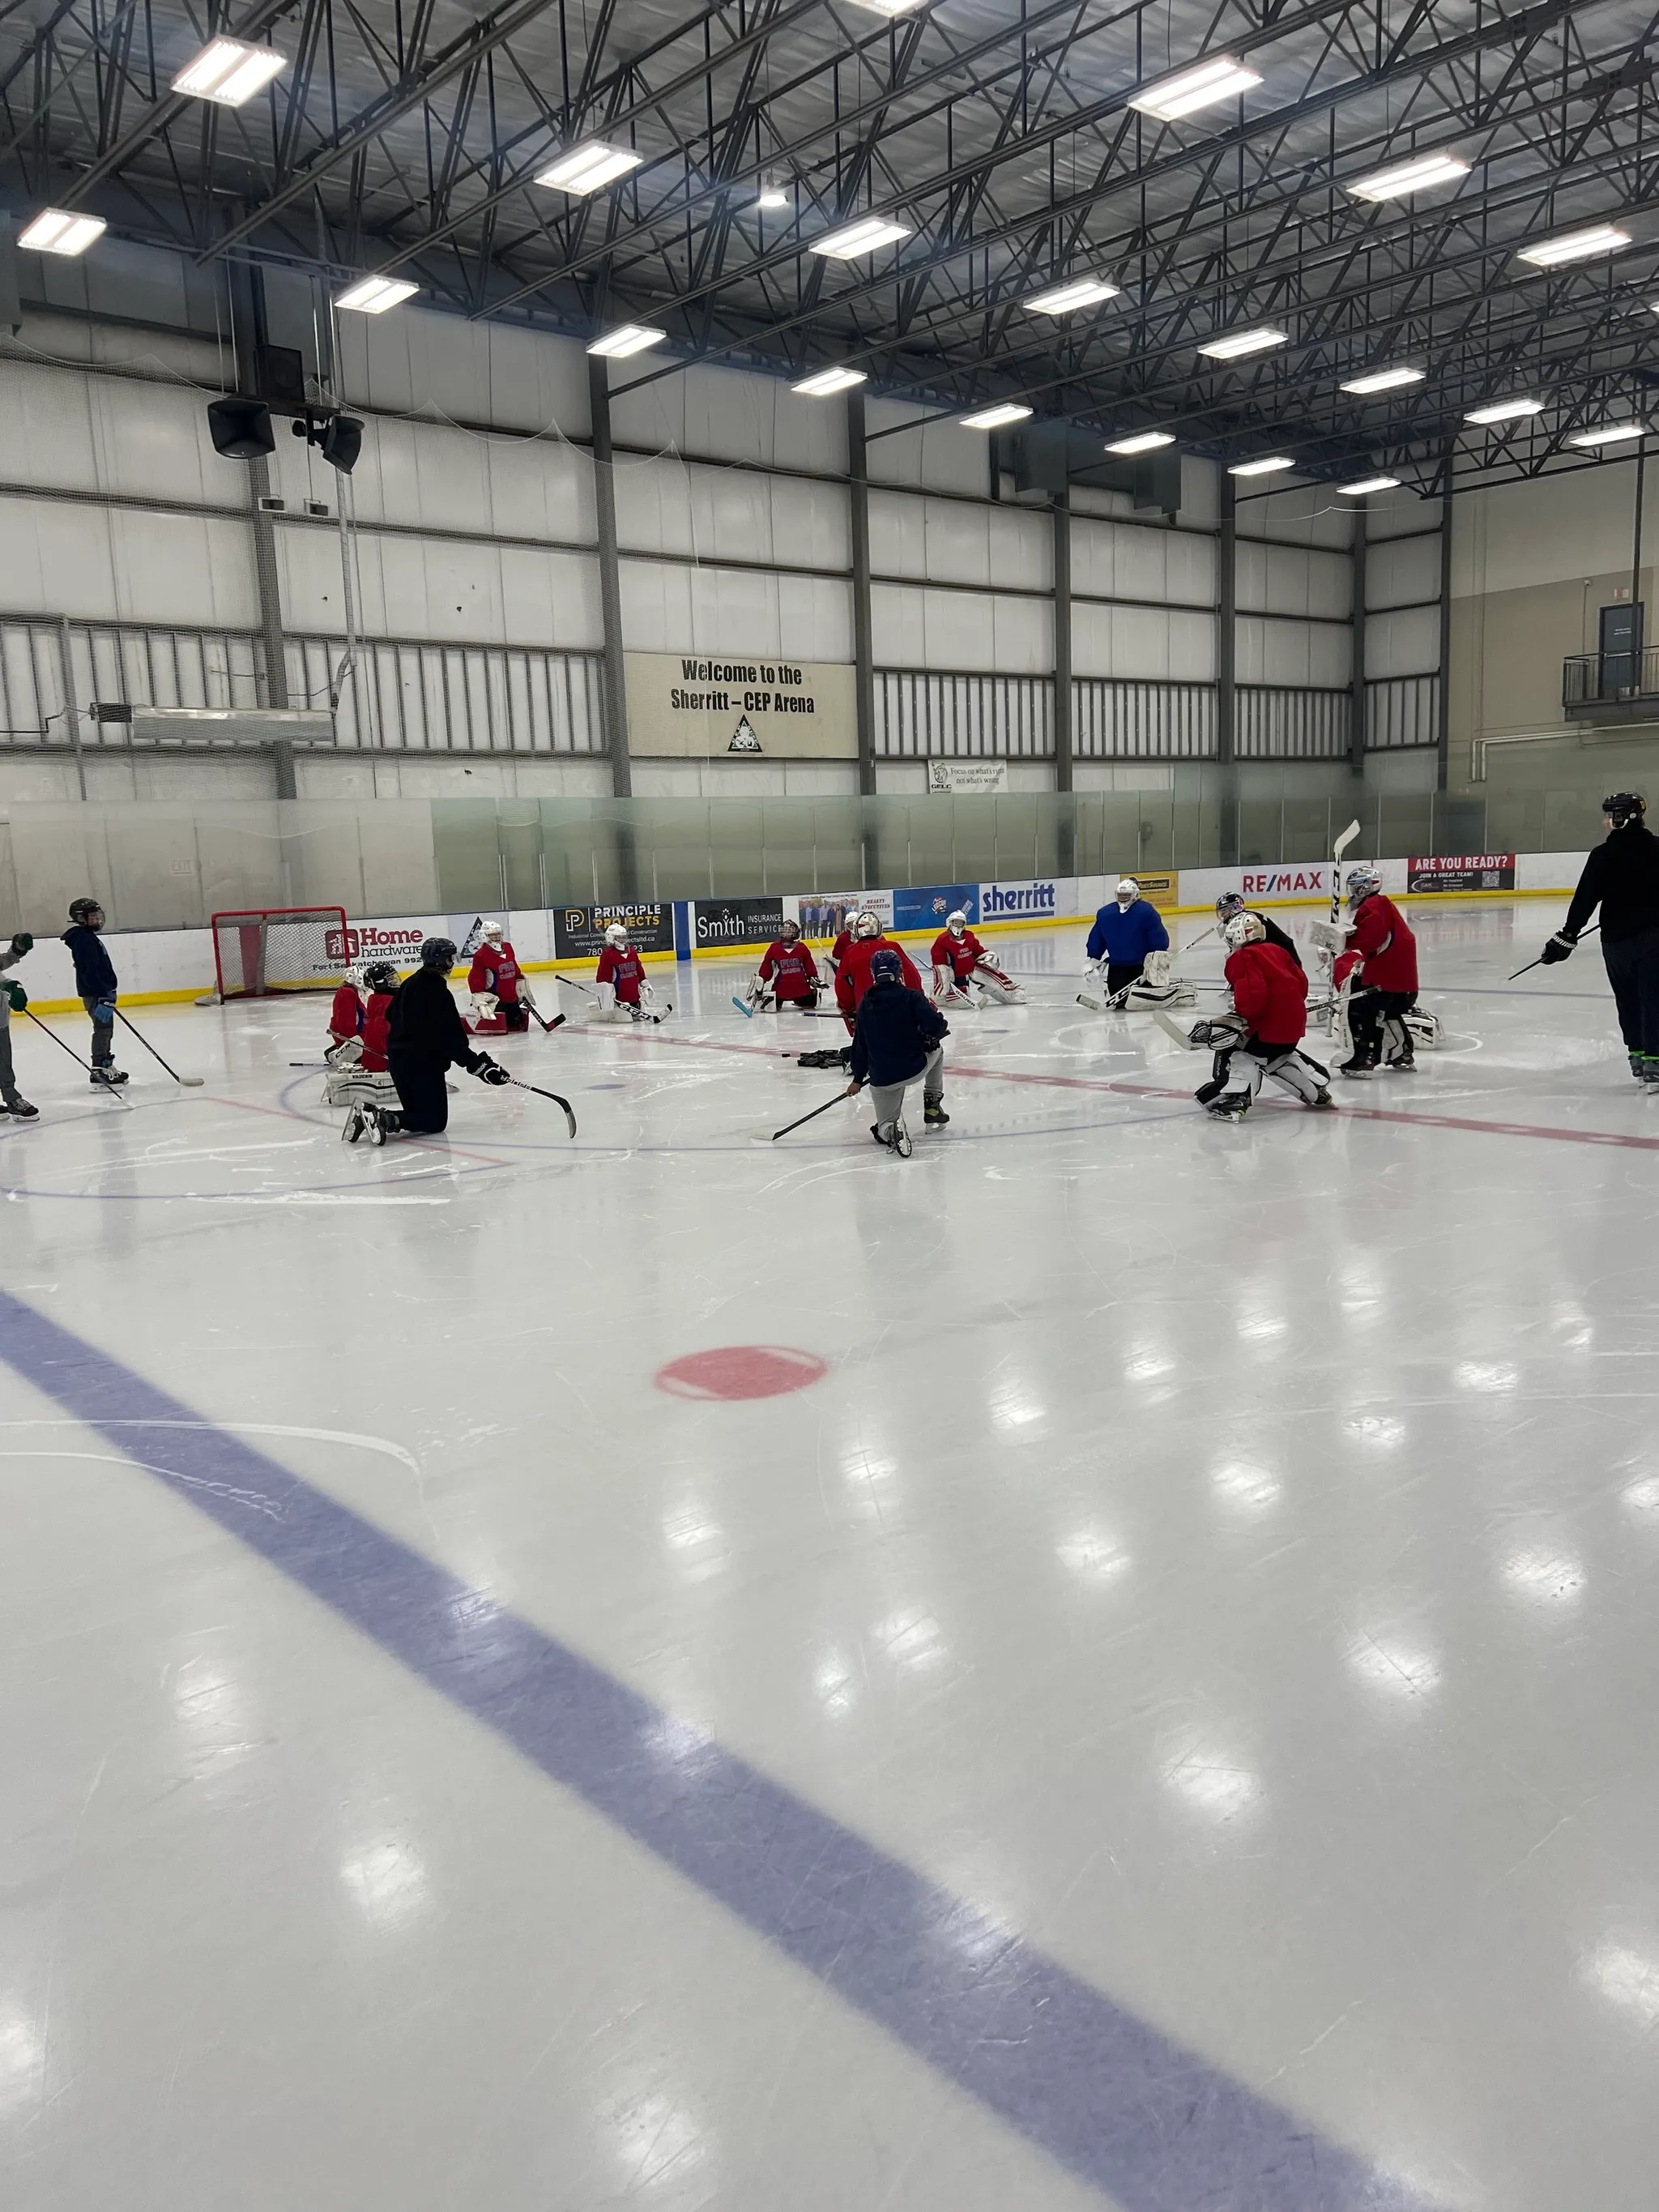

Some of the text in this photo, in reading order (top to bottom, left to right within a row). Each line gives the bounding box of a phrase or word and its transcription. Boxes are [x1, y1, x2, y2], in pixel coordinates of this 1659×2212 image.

[681, 659, 802, 685] Welcome to the
[671, 688, 729, 711] Sherritt
[744, 692, 771, 711] CEP
[774, 694, 814, 714] Arena
[956, 776, 966, 784] not
[1415, 856, 1508, 871] ARE YOU READY?
[1243, 871, 1322, 893] RE/MAX
[983, 882, 1055, 912] sherritt
[595, 904, 661, 917] PRINCIPLE
[595, 916, 659, 929] PROJECTS
[748, 914, 782, 923] INSURANCE
[697, 915, 744, 938] Smith
[360, 928, 424, 946] Home
[361, 945, 423, 958] hardware
[587, 948, 602, 956] 780
[620, 1005, 650, 1018] CCM
[335, 1043, 351, 1059] CCM
